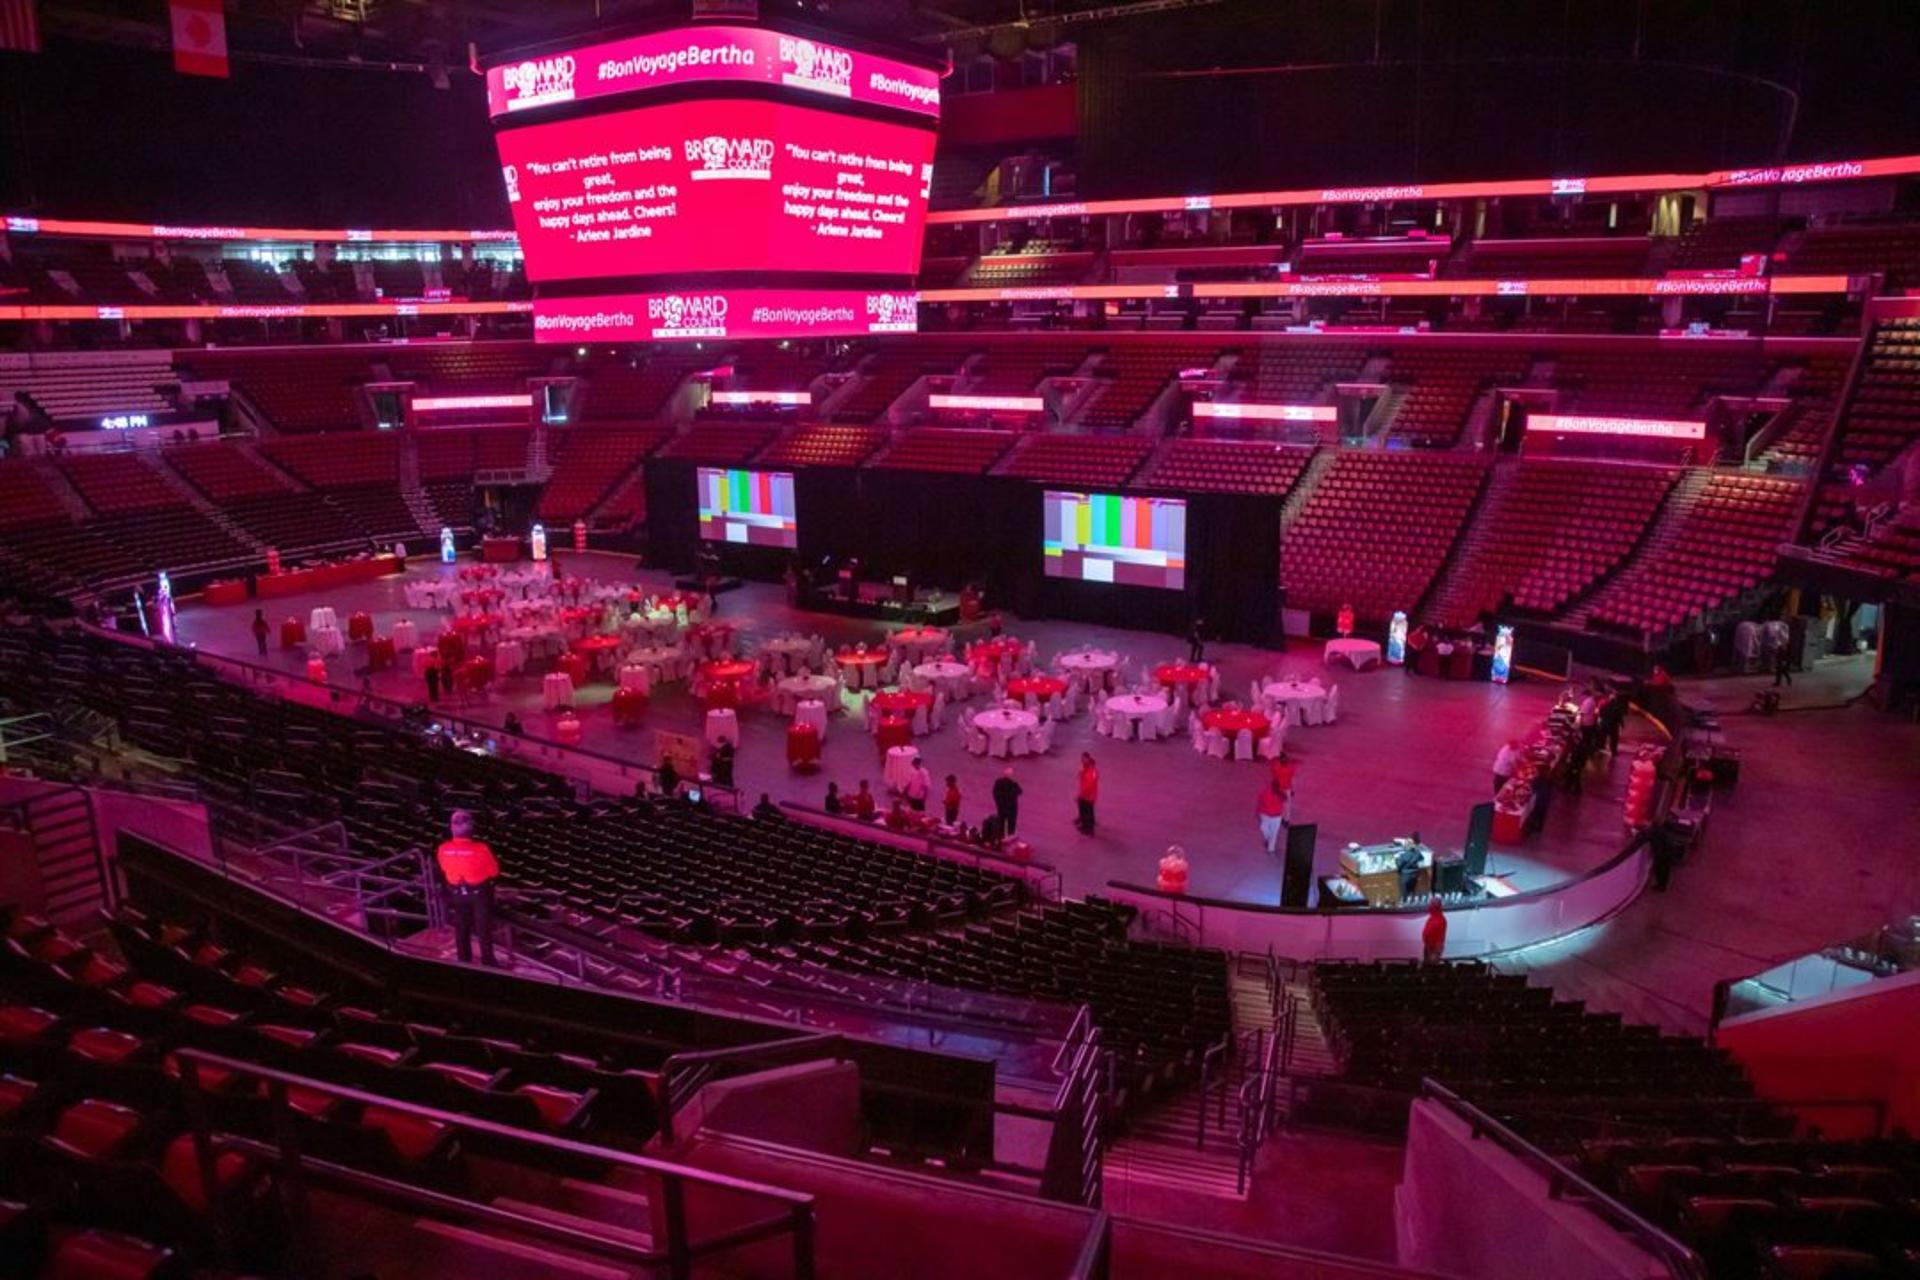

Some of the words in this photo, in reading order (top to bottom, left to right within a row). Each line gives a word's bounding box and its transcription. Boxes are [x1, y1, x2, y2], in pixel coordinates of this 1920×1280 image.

[597, 44, 755, 81] #BonVoyageBertha
[552, 158, 577, 173] can't
[579, 154, 608, 169] retire
[610, 150, 637, 165] from
[639, 145, 672, 161] being
[684, 136, 774, 162] BROWARD
[727, 158, 772, 170] COUNTY
[811, 149, 837, 163] can't
[837, 152, 864, 167] retire
[865, 156, 887, 170] from
[888, 159, 913, 176] being
[583, 172, 615, 189] great,
[836, 171, 864, 187] great,
[533, 197, 560, 212] enjoy
[562, 195, 584, 210] your
[586, 189, 633, 205] freedom
[634, 186, 655, 200] and
[657, 184, 677, 198] the
[782, 182, 811, 199] enjoy
[812, 187, 833, 200] your
[835, 187, 875, 204] freedom
[876, 193, 894, 206] and
[894, 194, 909, 207] the
[539, 215, 570, 229] happy
[572, 212, 594, 226] days
[597, 207, 632, 223] ahead.
[633, 202, 676, 219] Cheers!
[784, 201, 815, 218] happy
[817, 204, 839, 221] days
[576, 228, 610, 243] Arlene
[613, 224, 652, 240] Jardine
[817, 223, 849, 237] Arlene
[850, 225, 883, 240] Jardine
[648, 295, 728, 319] BROWARD
[752, 306, 854, 325] #BonVoyageBertha
[535, 312, 634, 331] #BonVoyageBertha
[682, 316, 726, 328] COUNTY
